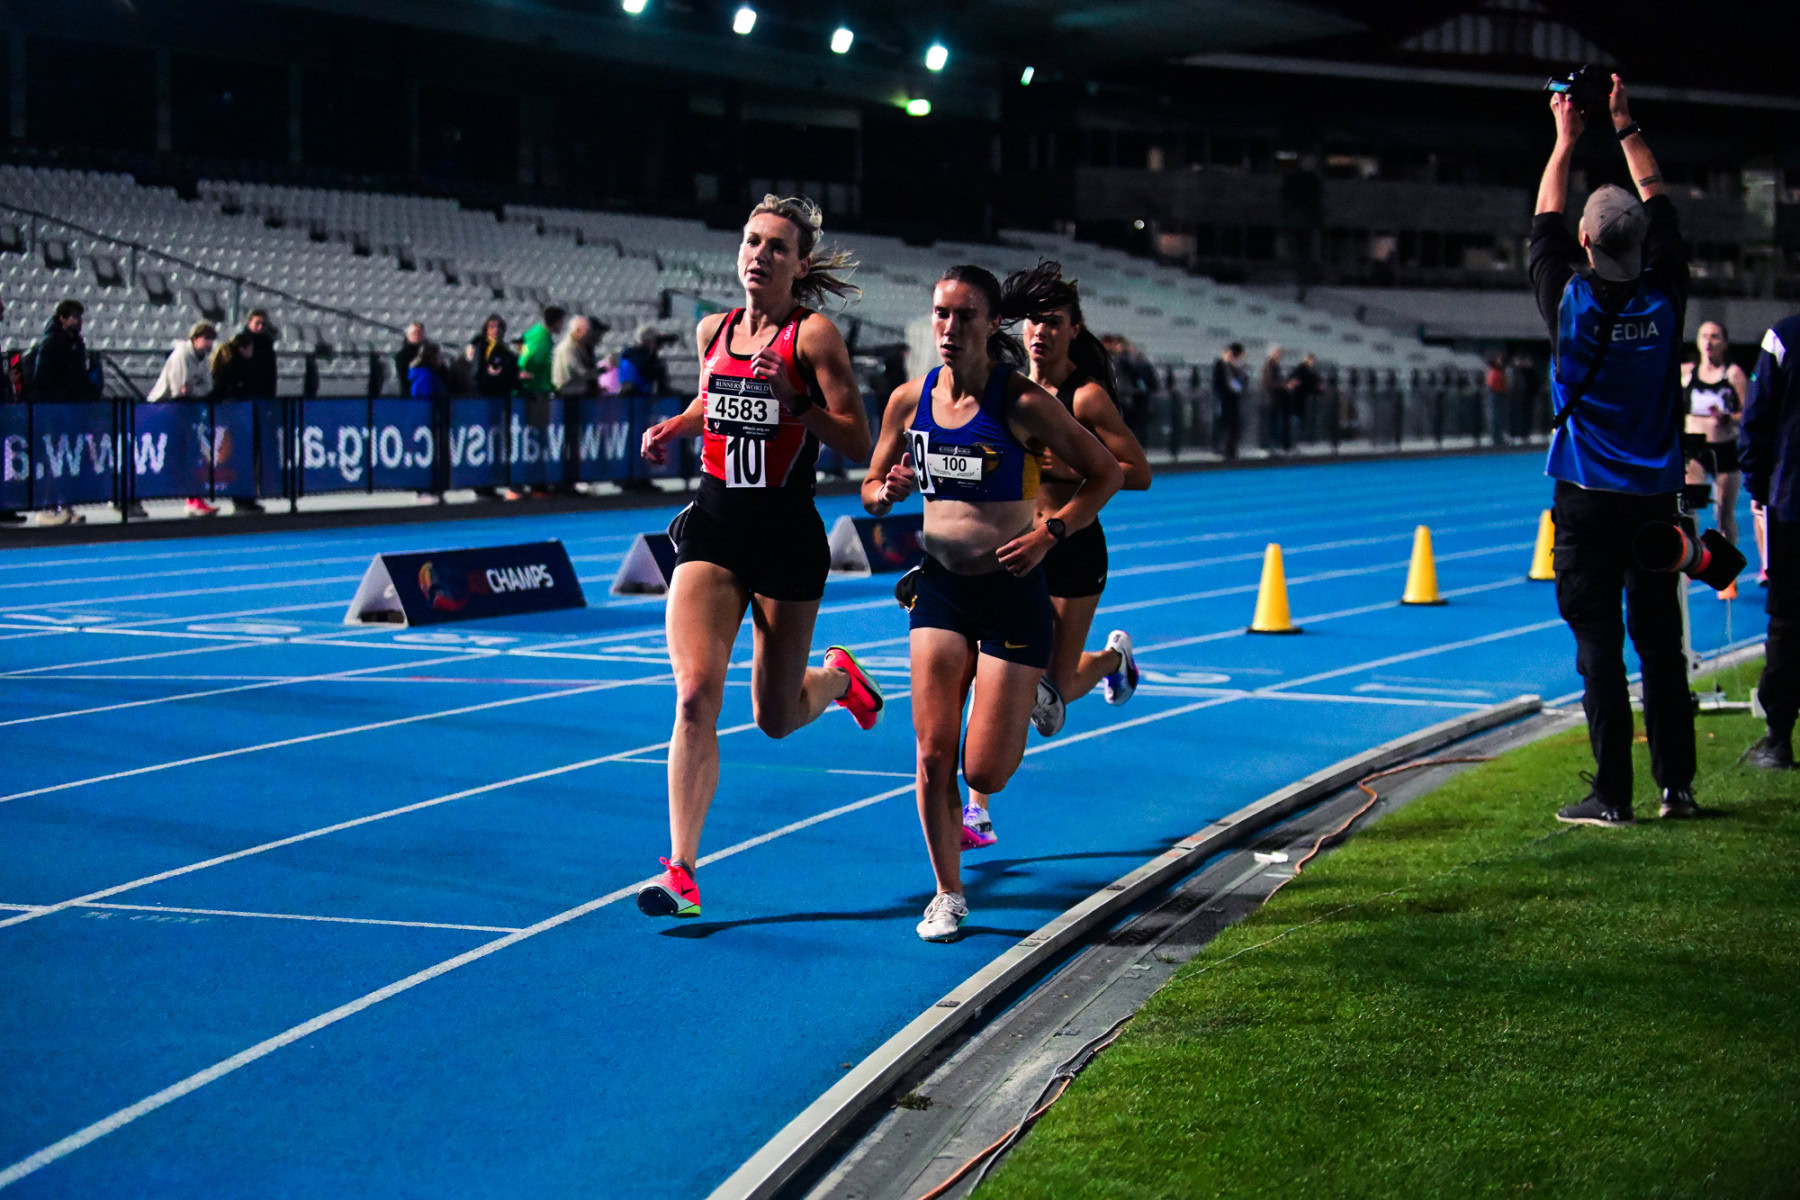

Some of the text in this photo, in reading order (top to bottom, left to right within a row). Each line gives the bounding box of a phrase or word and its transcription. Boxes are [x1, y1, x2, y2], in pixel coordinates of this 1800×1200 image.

[715, 396, 768, 422] 4583
[727, 436, 762, 485] 10
[914, 434, 929, 490] 9
[942, 456, 967, 472] 100
[485, 563, 555, 595] CHAMPS
